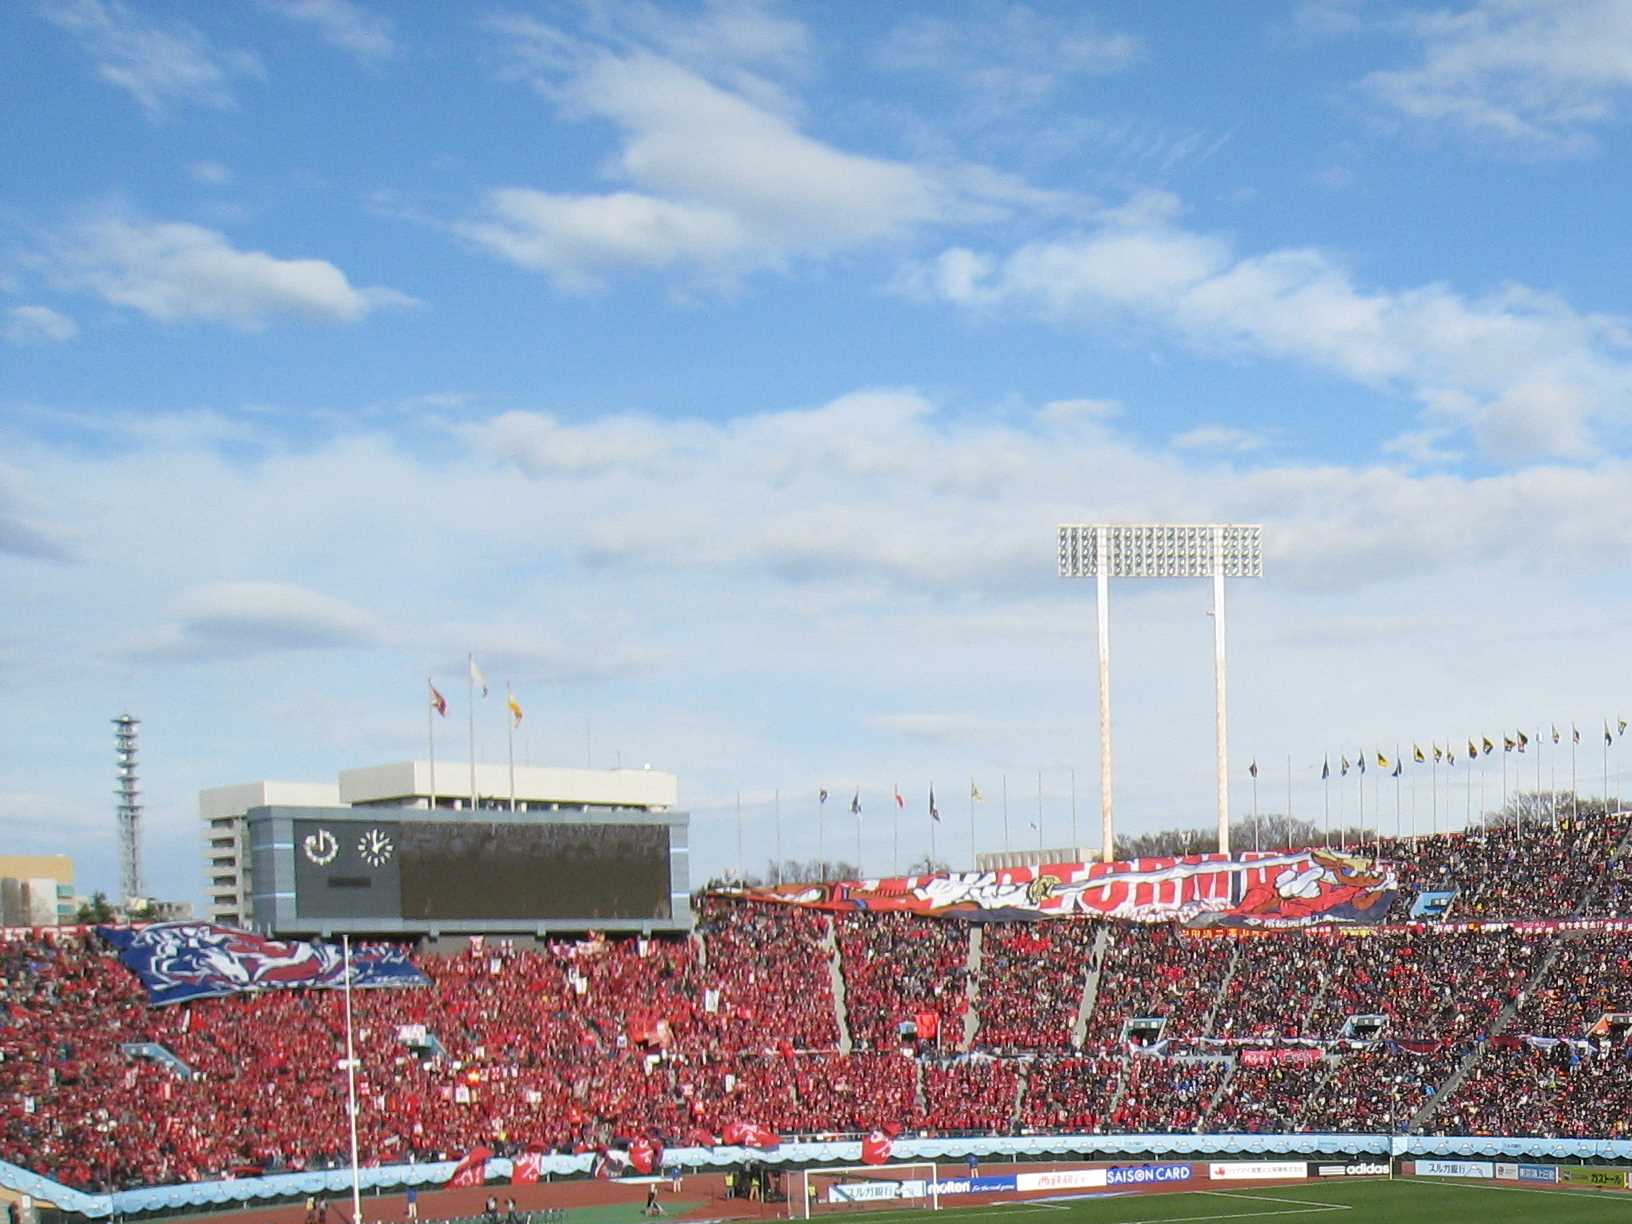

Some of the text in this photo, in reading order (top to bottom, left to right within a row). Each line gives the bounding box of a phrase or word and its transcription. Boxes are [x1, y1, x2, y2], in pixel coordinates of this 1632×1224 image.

[1107, 1166, 1190, 1184] SAISON CARD
[1346, 1162, 1390, 1176] adidas
[1429, 1162, 1467, 1175] スルガ銀行
